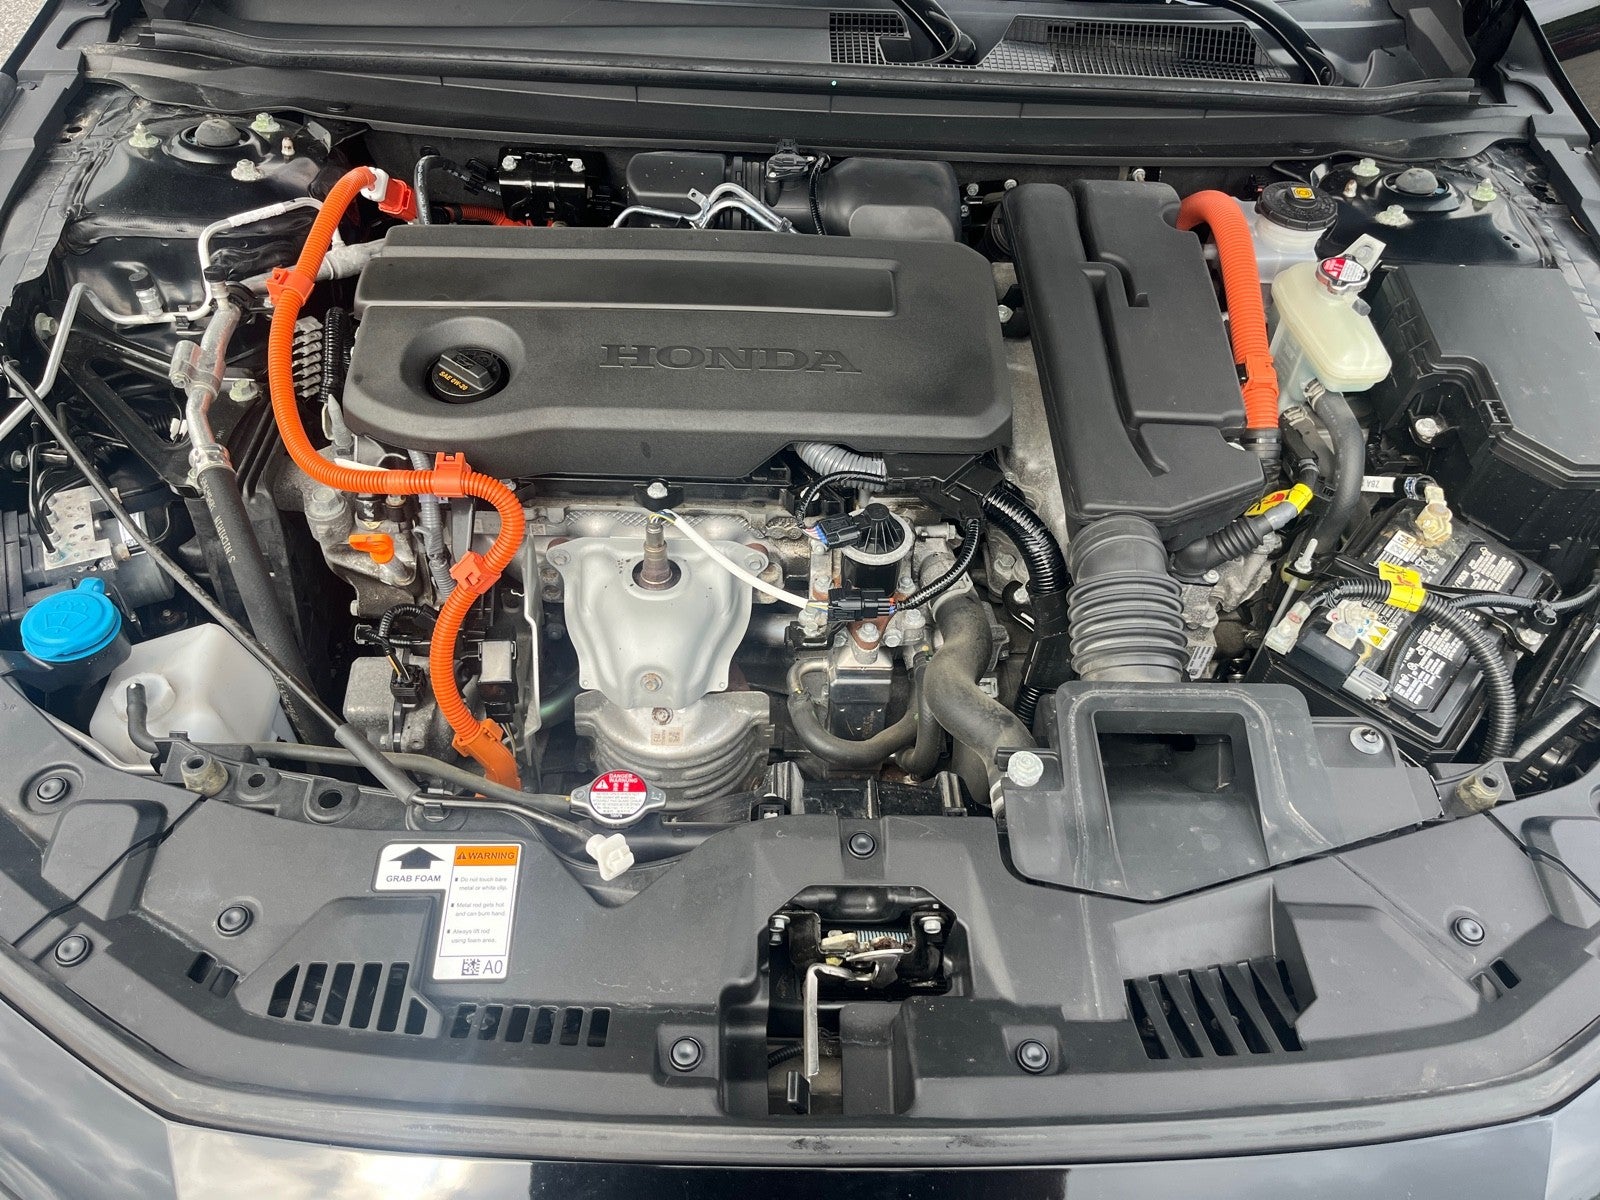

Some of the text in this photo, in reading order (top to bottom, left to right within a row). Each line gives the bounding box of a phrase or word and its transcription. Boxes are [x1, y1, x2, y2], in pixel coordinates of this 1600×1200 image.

[599, 344, 862, 375] HONDA
[438, 370, 469, 391] SAE 0W-20
[468, 851, 516, 860] WARNING
[385, 874, 442, 883] GRAB FOAM
[482, 959, 504, 975] A0
